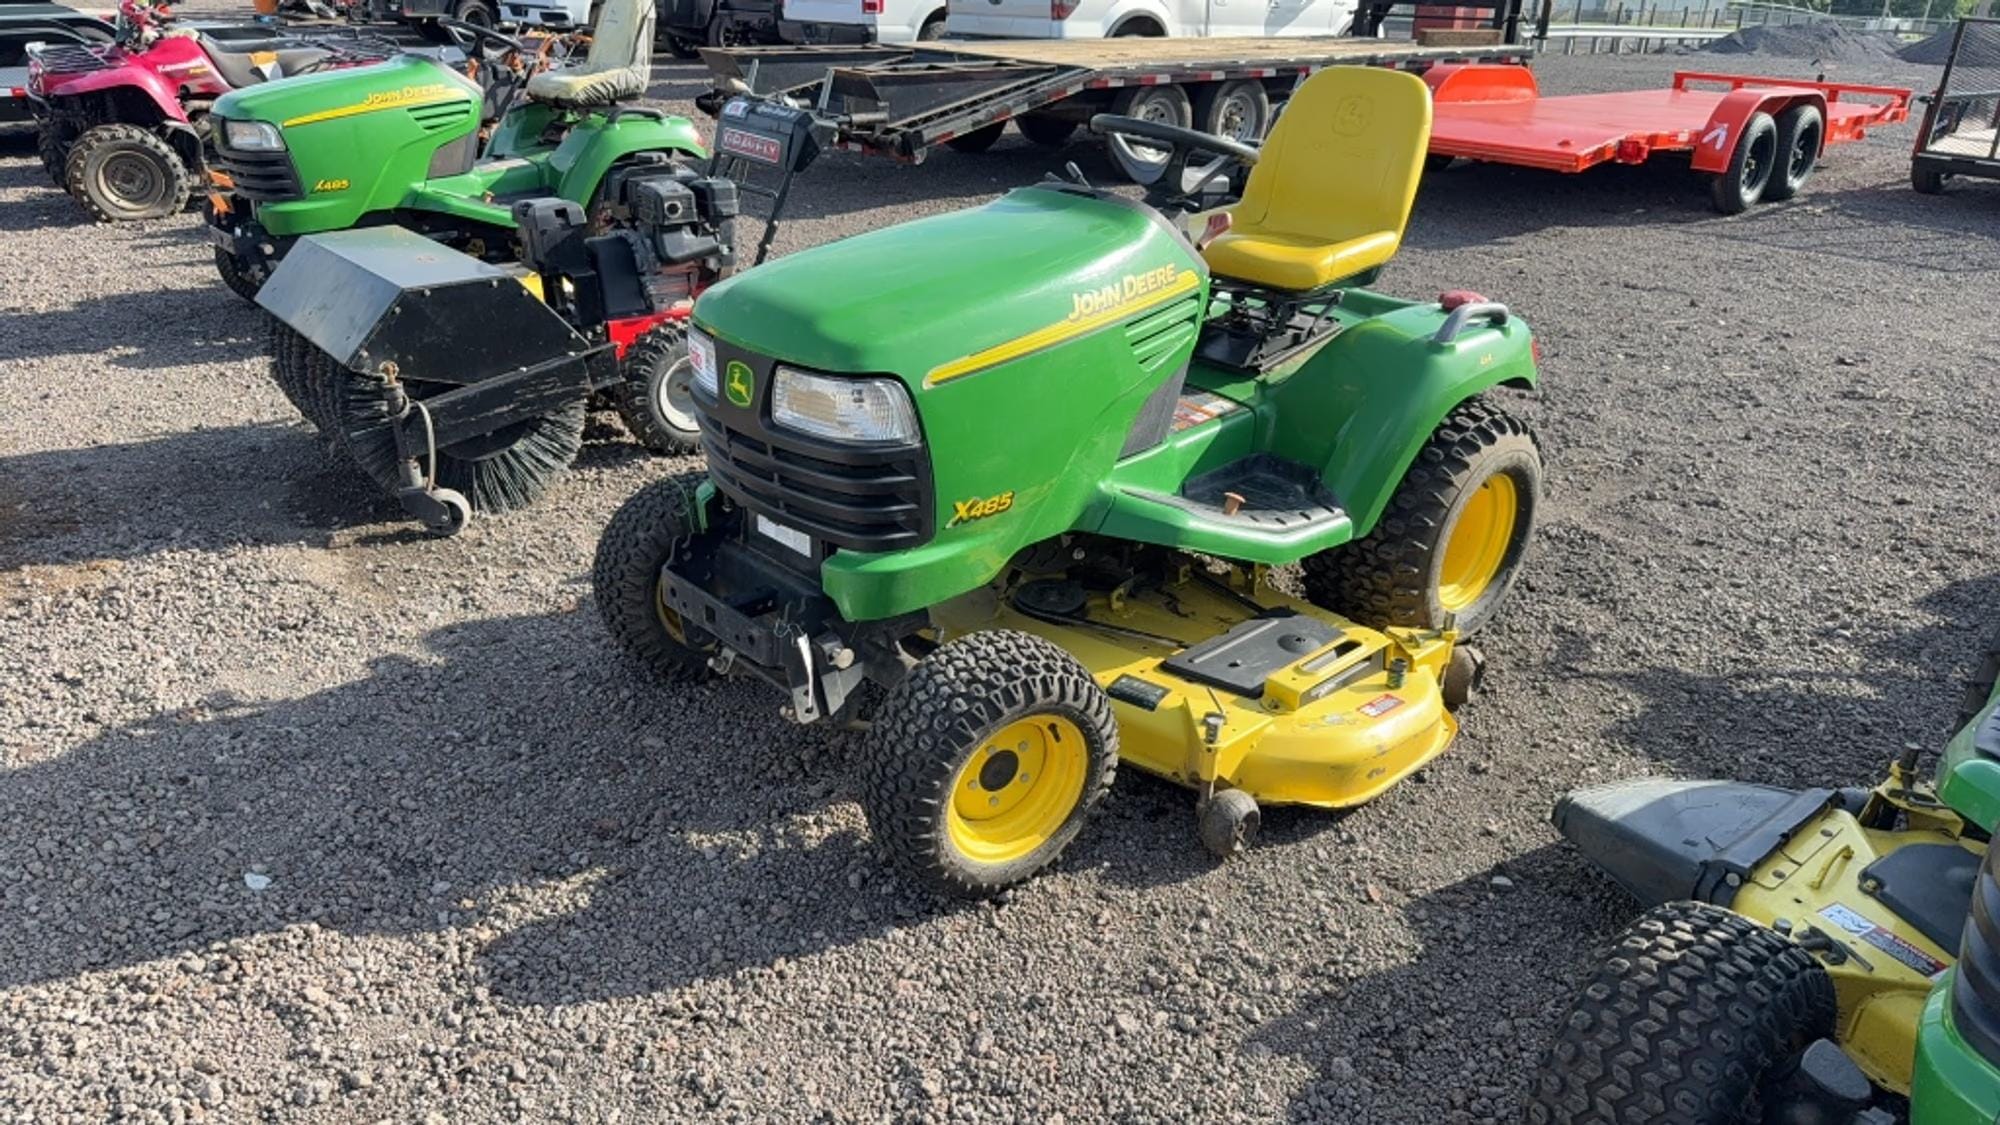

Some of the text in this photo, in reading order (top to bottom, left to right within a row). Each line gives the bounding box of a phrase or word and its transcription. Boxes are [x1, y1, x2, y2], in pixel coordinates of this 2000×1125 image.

[363, 91, 400, 106] JOHN
[1068, 263, 1176, 320] JOHN DEERE
[945, 490, 1014, 528] X485
